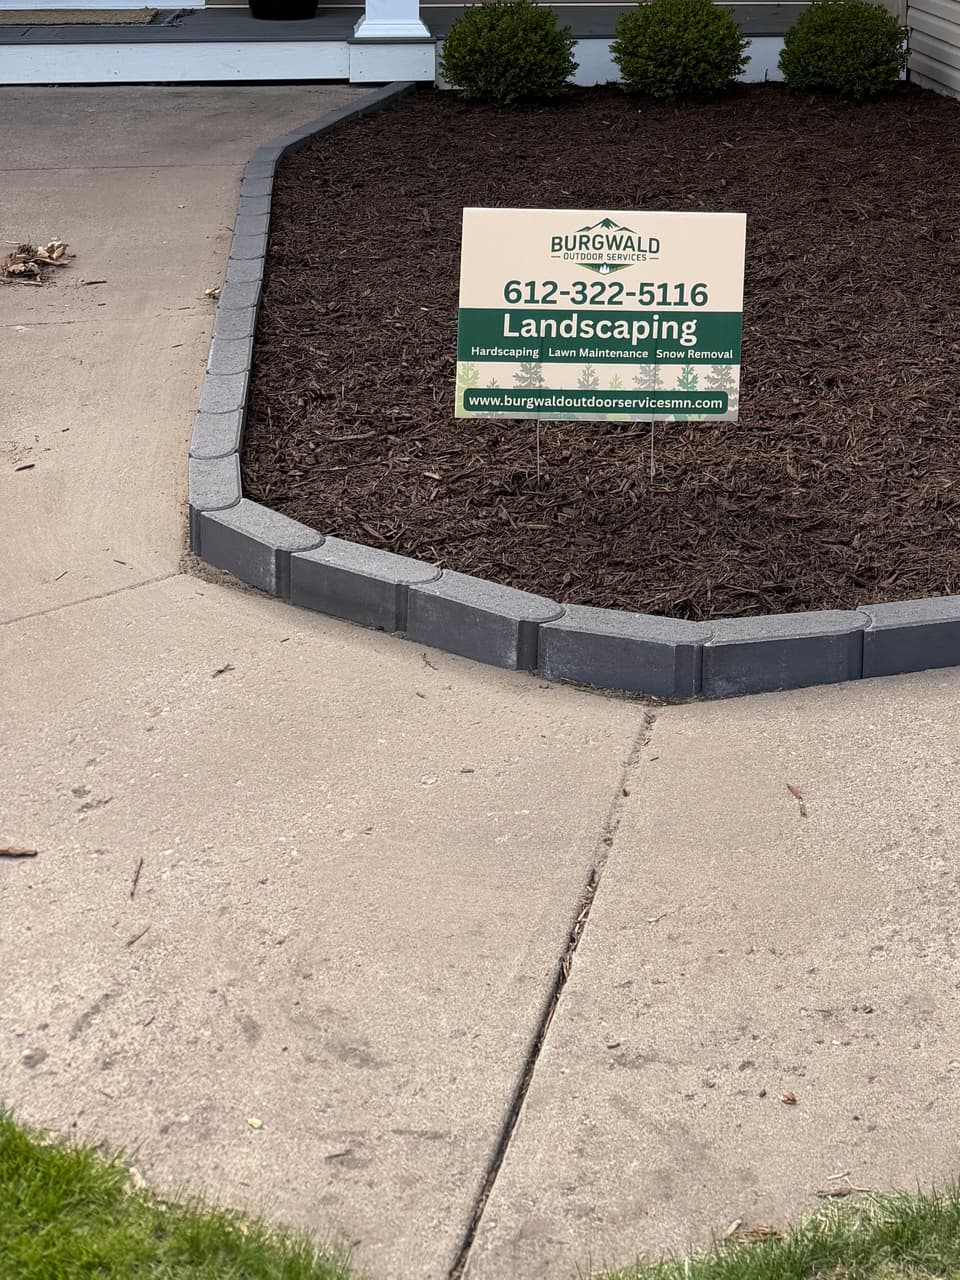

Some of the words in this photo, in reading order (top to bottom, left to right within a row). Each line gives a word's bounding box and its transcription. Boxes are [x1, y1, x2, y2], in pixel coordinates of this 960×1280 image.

[551, 234, 660, 254] BURGWALD
[563, 252, 603, 261] OUTDOOR
[606, 253, 647, 262] SERVICES
[503, 280, 709, 307] 612-322-5116
[503, 313, 698, 346] Landscaping
[471, 346, 539, 359] Hardscaping
[548, 347, 577, 358] Lawn
[579, 347, 649, 359] Maintenance
[656, 349, 685, 359] Snow
[687, 349, 733, 359] Removal
[468, 394, 723, 409] www.burgwaldoutdoorservicesmn.com
